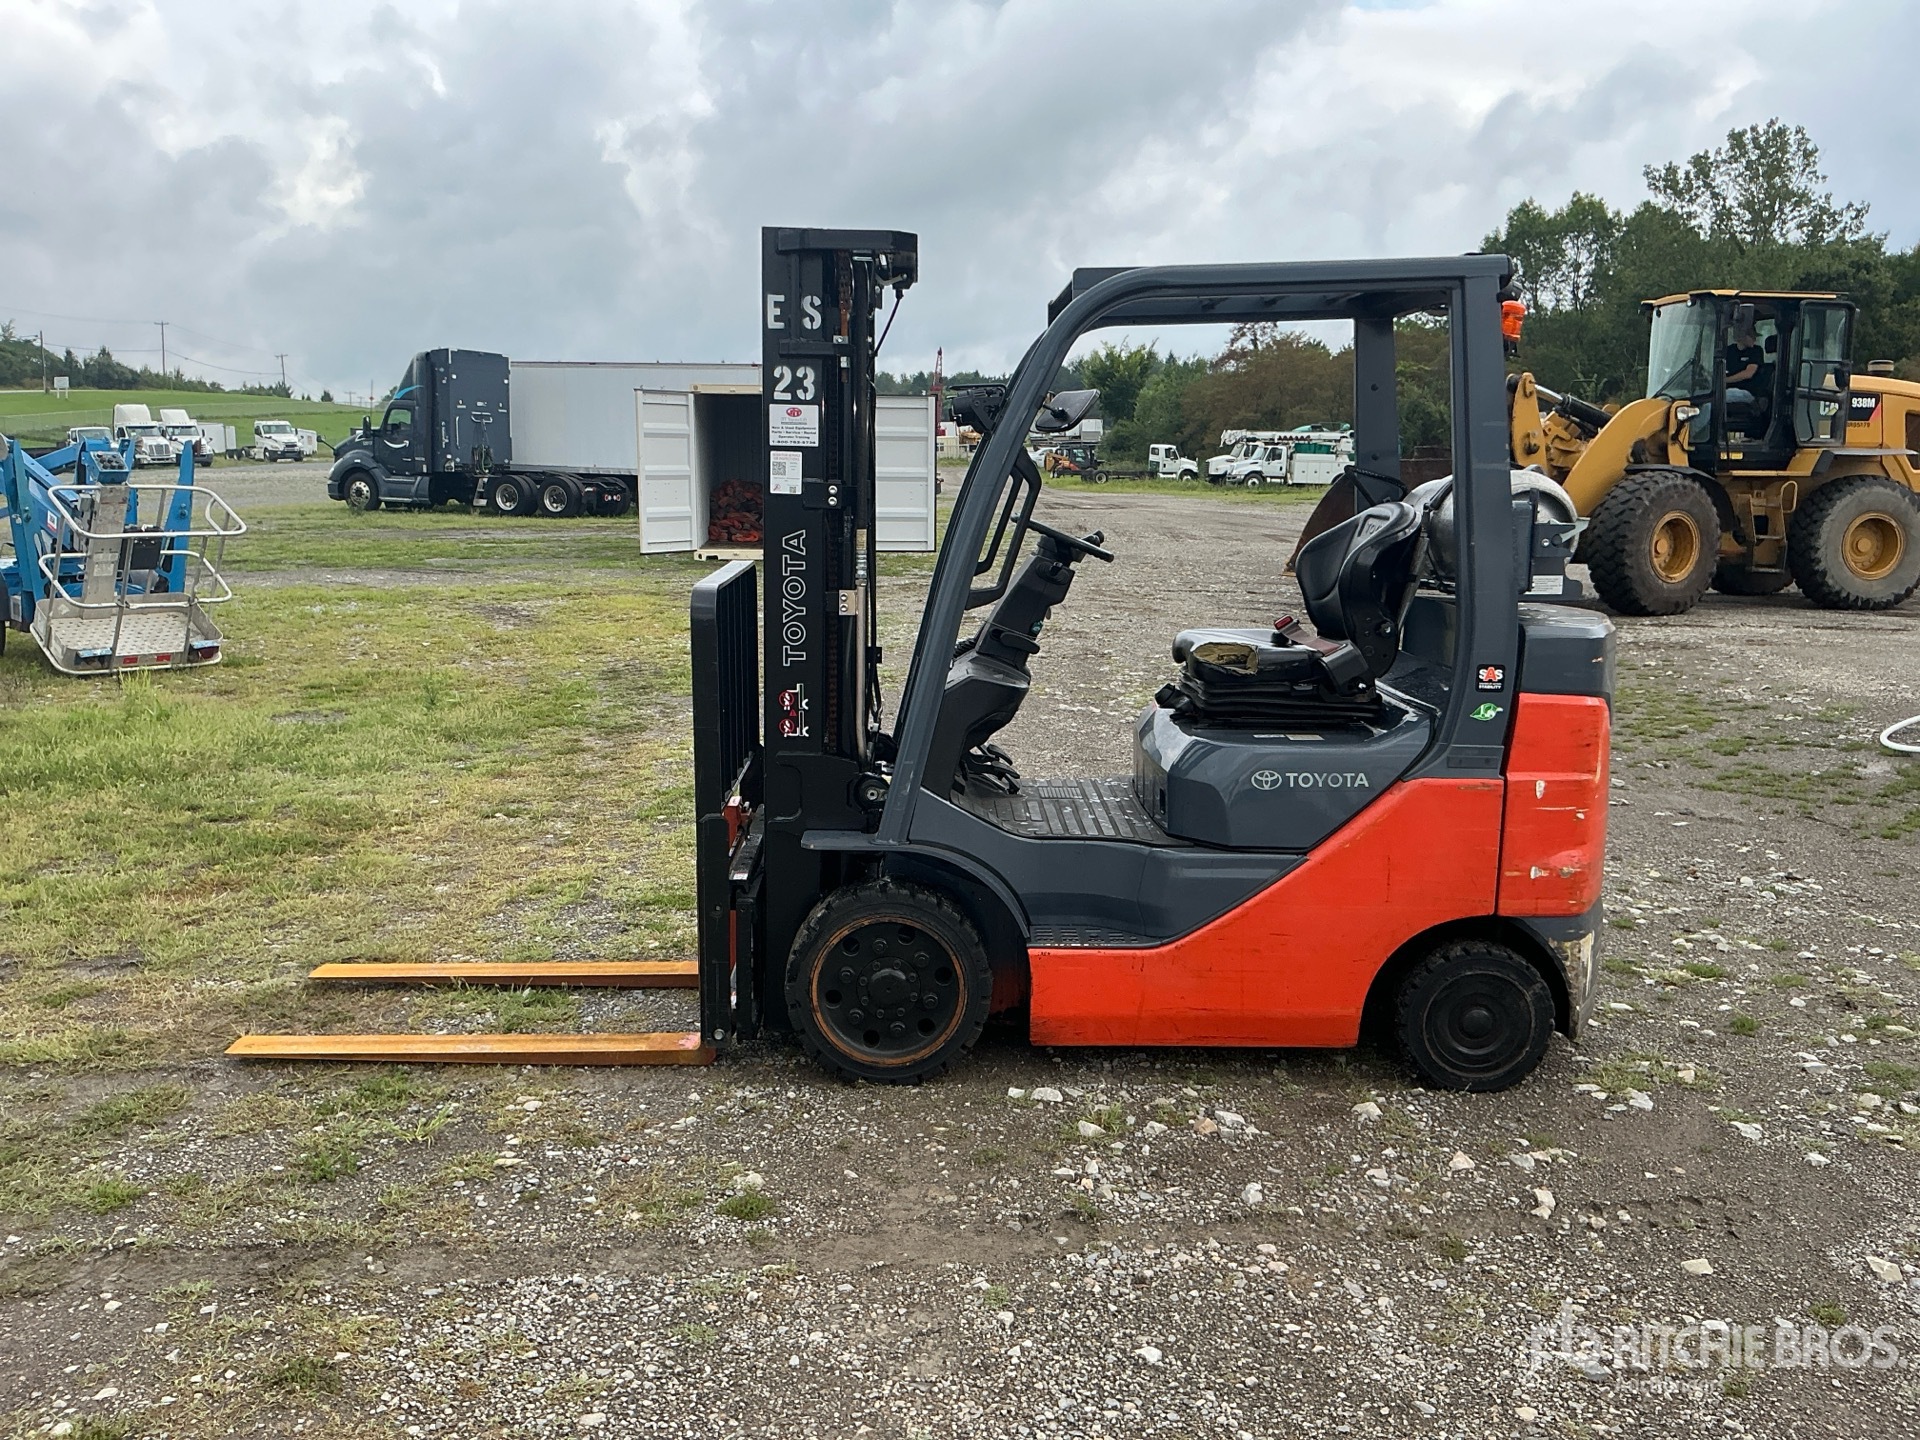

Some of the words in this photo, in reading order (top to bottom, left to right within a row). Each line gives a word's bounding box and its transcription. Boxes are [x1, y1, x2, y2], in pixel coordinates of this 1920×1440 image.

[773, 366, 816, 401] 23
[1851, 398, 1876, 408] 938M
[782, 529, 806, 666] TOYOTA
[1478, 666, 1504, 682] SAS
[1285, 772, 1370, 788] TOYOTA
